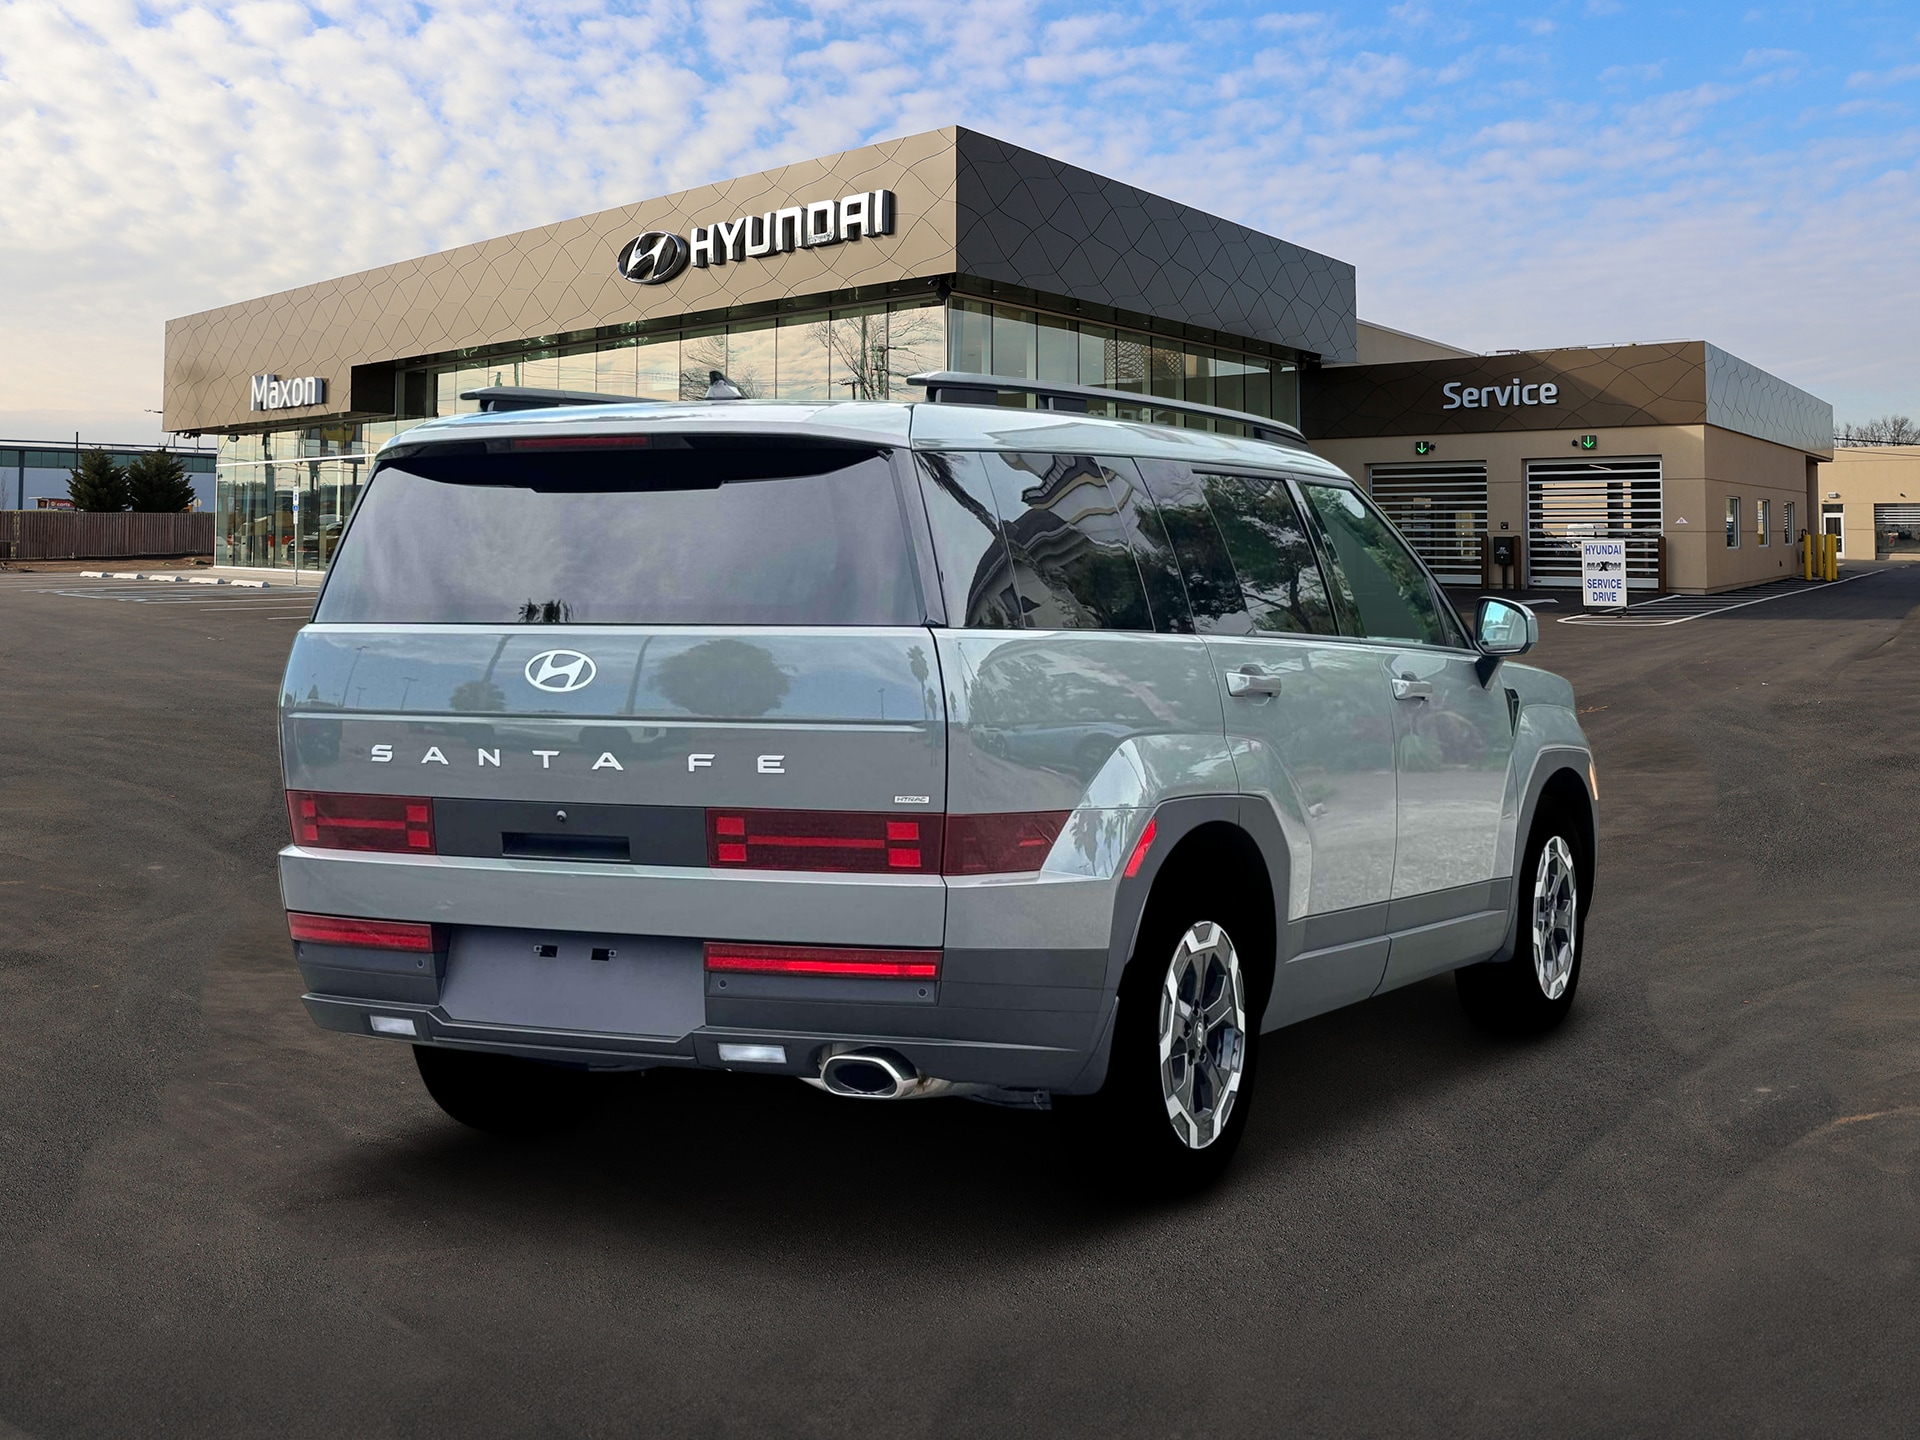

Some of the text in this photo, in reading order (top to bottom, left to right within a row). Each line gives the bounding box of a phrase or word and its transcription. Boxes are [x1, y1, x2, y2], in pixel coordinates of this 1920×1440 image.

[690, 189, 891, 267] HYUNDAI
[250, 374, 319, 411] Maxon
[1443, 378, 1558, 409] Service
[1585, 545, 1622, 555] HYUNDAI
[1586, 561, 1621, 571] MAXON
[1587, 579, 1622, 589] SERVICE
[1592, 592, 1617, 602] DRIVE
[371, 744, 786, 774] SANTA FE
